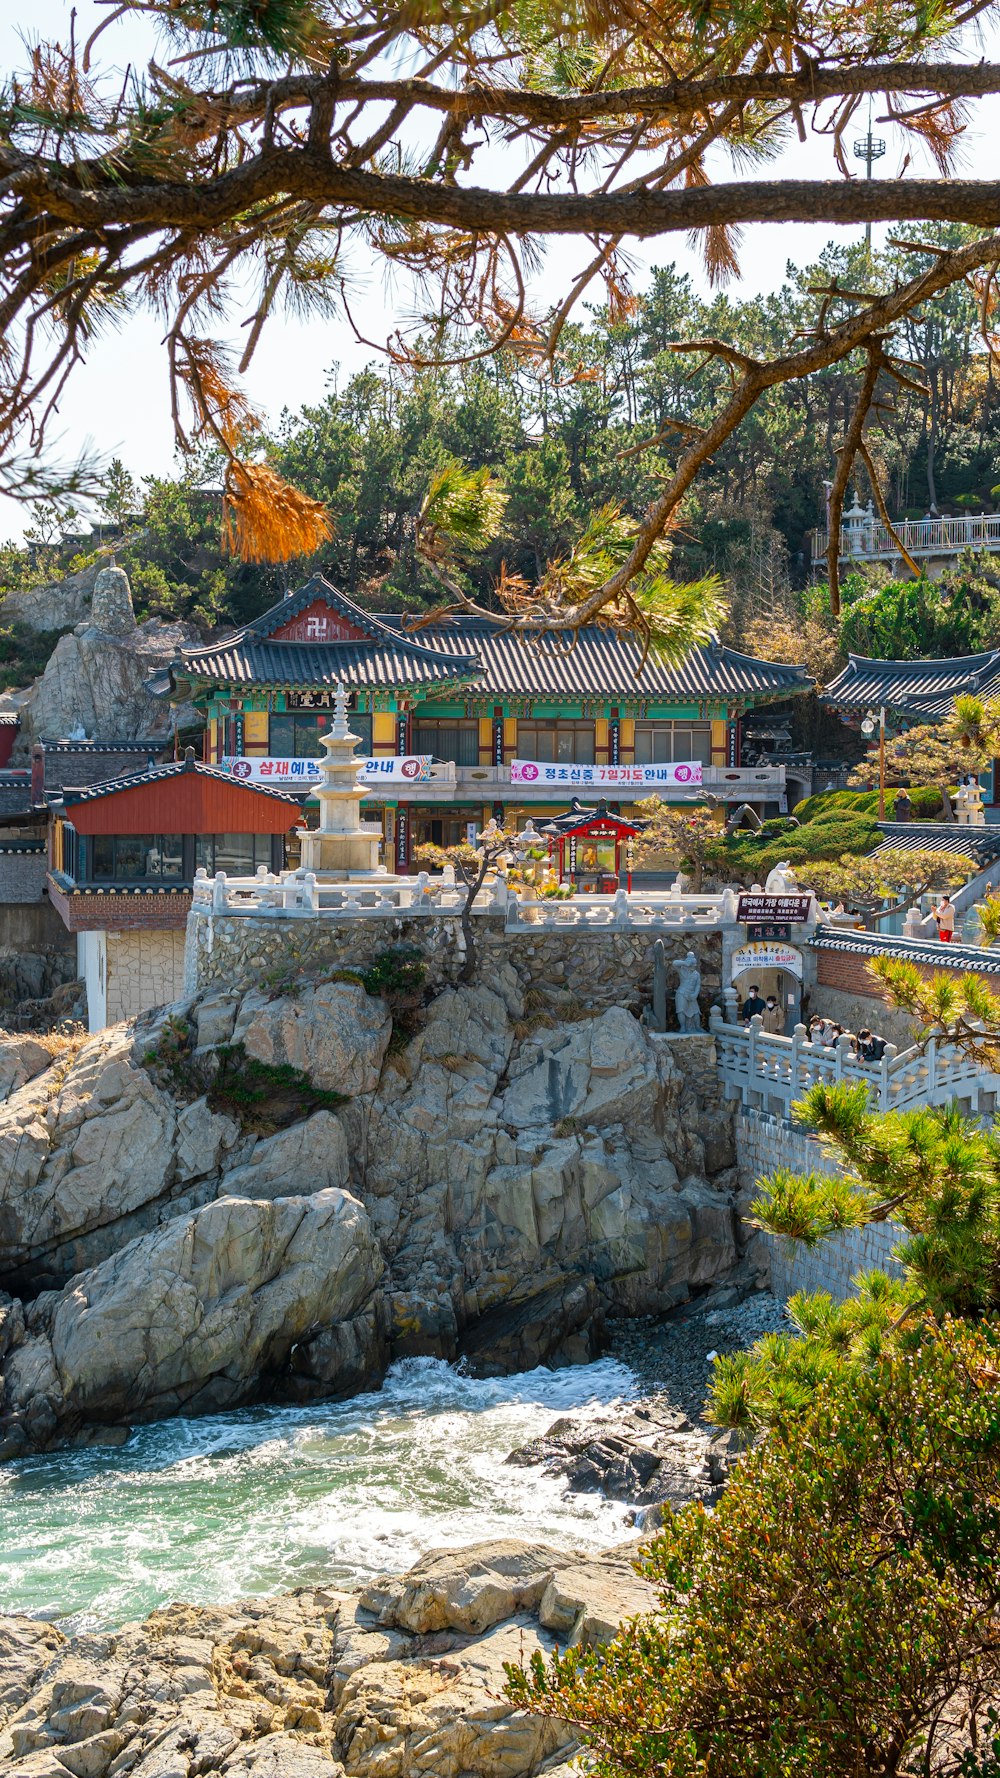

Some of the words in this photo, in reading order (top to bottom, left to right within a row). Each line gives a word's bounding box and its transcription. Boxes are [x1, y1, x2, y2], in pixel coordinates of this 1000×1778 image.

[235, 763, 249, 777] 봉
[365, 761, 395, 774] 안내
[404, 762, 417, 776] 행
[524, 765, 537, 780] 봉
[544, 768, 593, 781] 정초신중
[677, 767, 689, 781] 행
[741, 898, 764, 907] 한국에서
[765, 898, 777, 907] 가장
[778, 898, 800, 908] 아름다운
